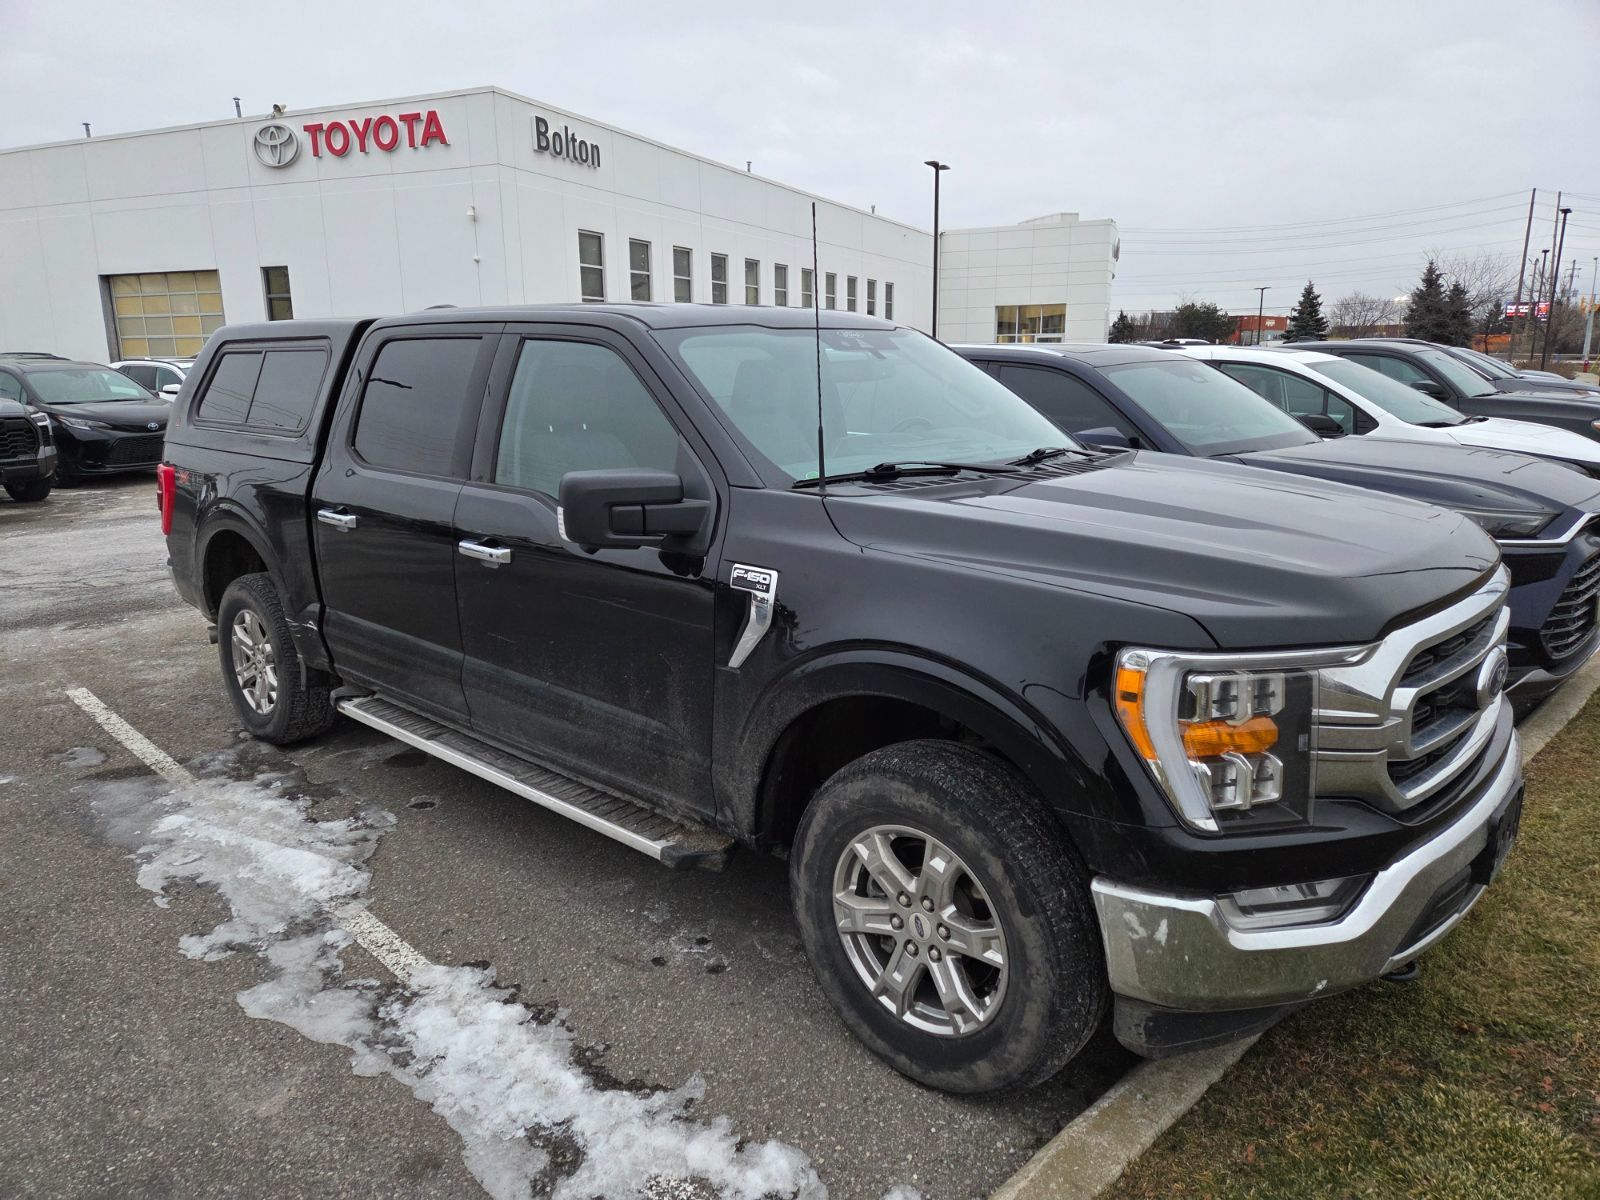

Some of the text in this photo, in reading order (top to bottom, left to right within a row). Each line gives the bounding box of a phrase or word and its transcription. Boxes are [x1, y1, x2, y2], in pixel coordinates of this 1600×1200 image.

[303, 110, 448, 157] TOYOTA
[533, 115, 601, 168] Bolton
[733, 569, 770, 585] F-150
